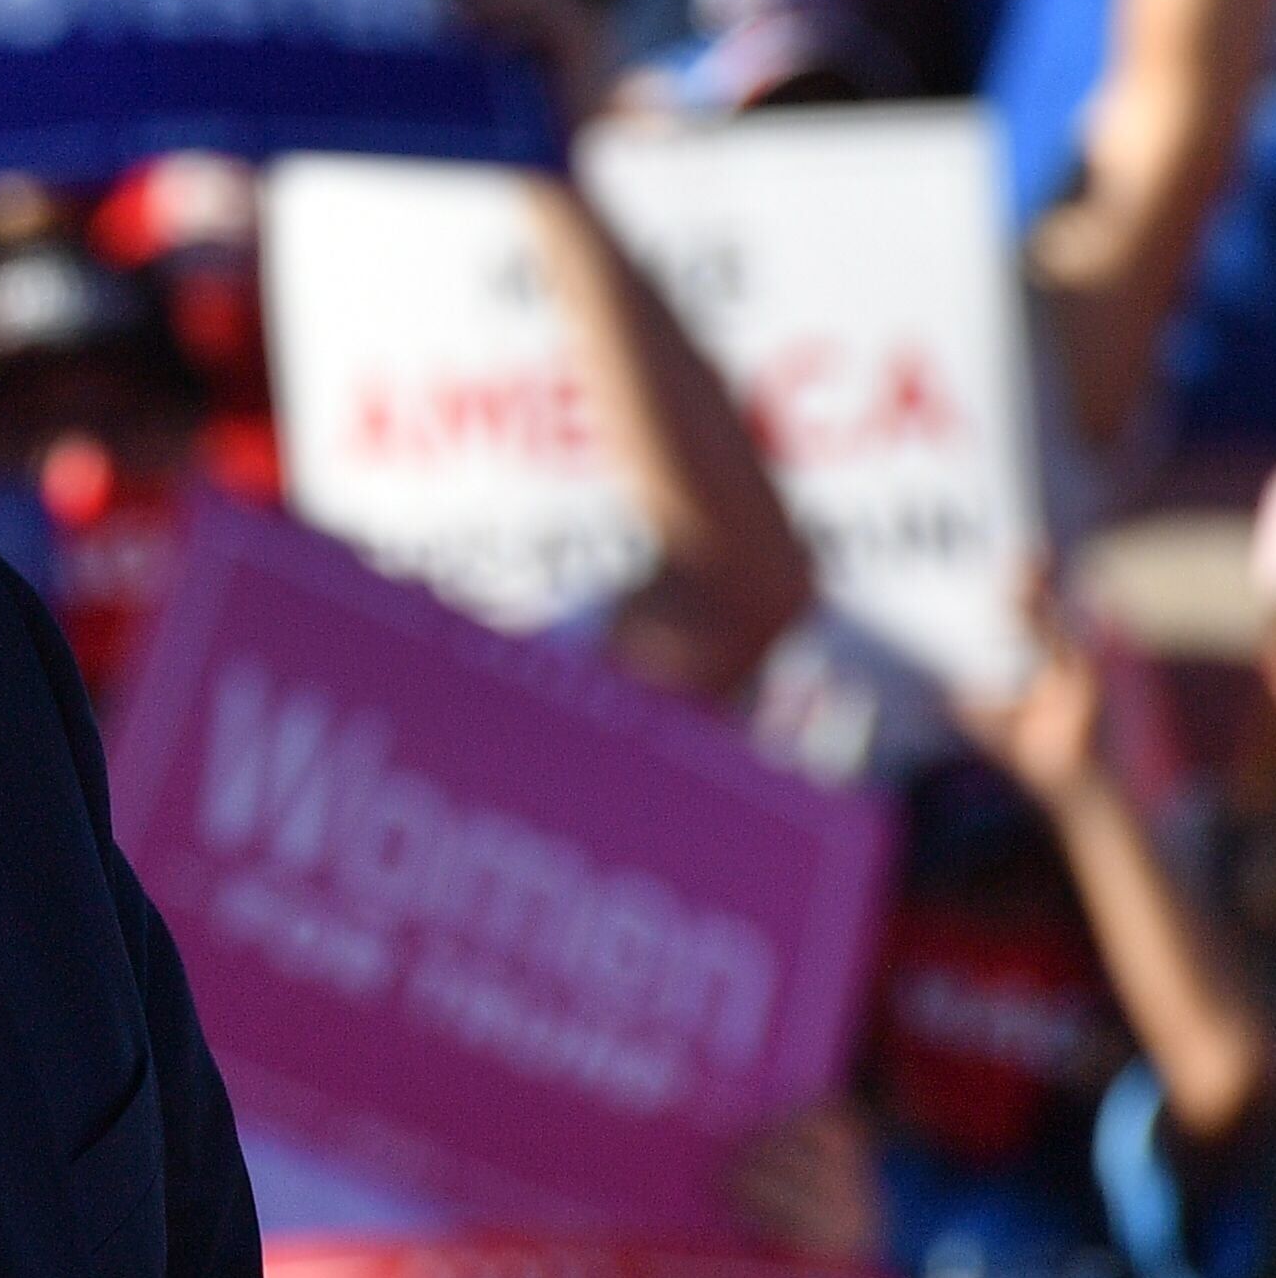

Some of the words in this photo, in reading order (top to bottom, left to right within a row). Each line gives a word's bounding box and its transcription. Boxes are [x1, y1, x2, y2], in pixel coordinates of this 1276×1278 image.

[198, 654, 780, 1070] Women
[216, 877, 388, 997] FOR
[410, 947, 678, 1110] TRUMP
